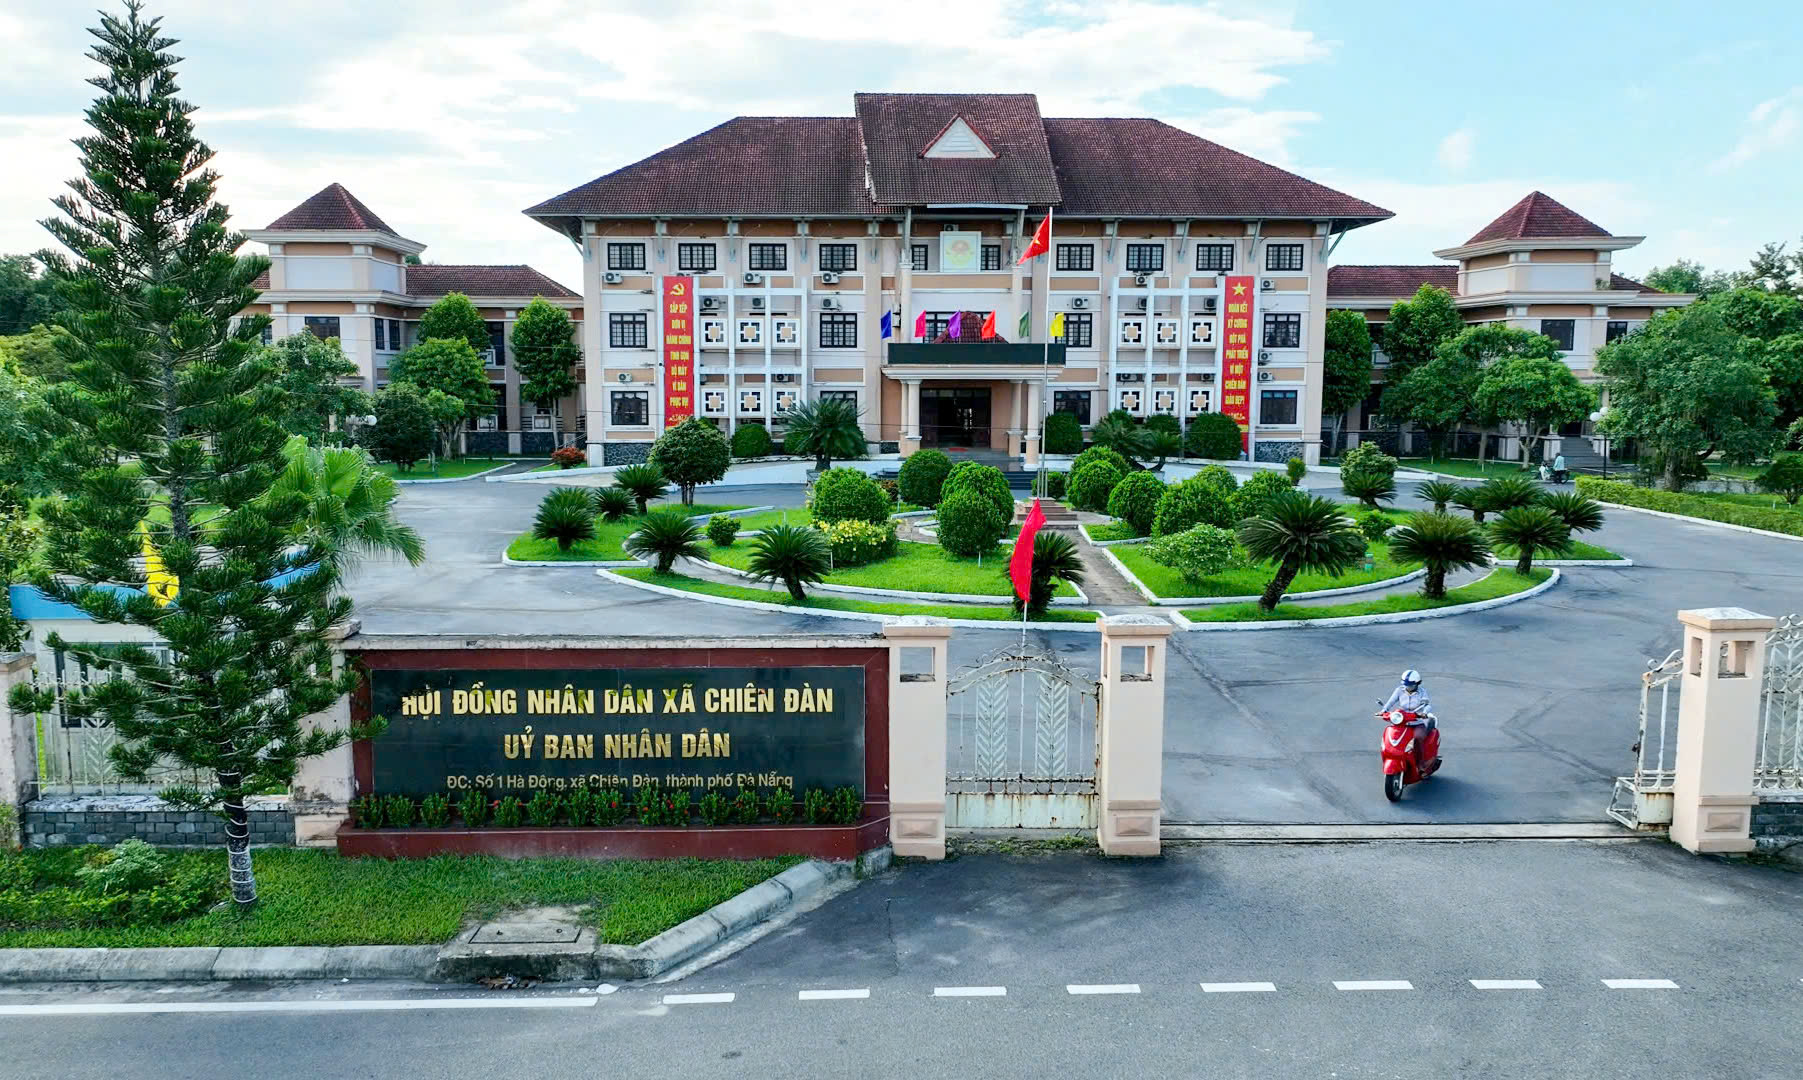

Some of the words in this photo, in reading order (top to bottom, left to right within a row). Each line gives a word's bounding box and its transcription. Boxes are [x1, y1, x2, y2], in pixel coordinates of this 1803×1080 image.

[527, 684, 594, 714] NHÂN
[604, 683, 654, 714] DÂN
[662, 683, 696, 714] XÃ
[704, 683, 774, 713] CHIÊN
[783, 682, 833, 713] ĐÀN
[504, 725, 535, 760] UỶ
[544, 734, 594, 759] BAN
[604, 728, 672, 759] NHÂN
[681, 727, 730, 758] DÂN
[447, 775, 472, 789] ĐC:
[475, 772, 494, 788] Số
[497, 775, 503, 788] 1
[507, 774, 525, 789] Hà
[570, 774, 586, 788] xã
[589, 774, 628, 788] Chiên
[666, 773, 704, 787] thành
[708, 772, 734, 790] phố
[737, 772, 755, 787] Đà
[758, 771, 793, 789] Nẵng
